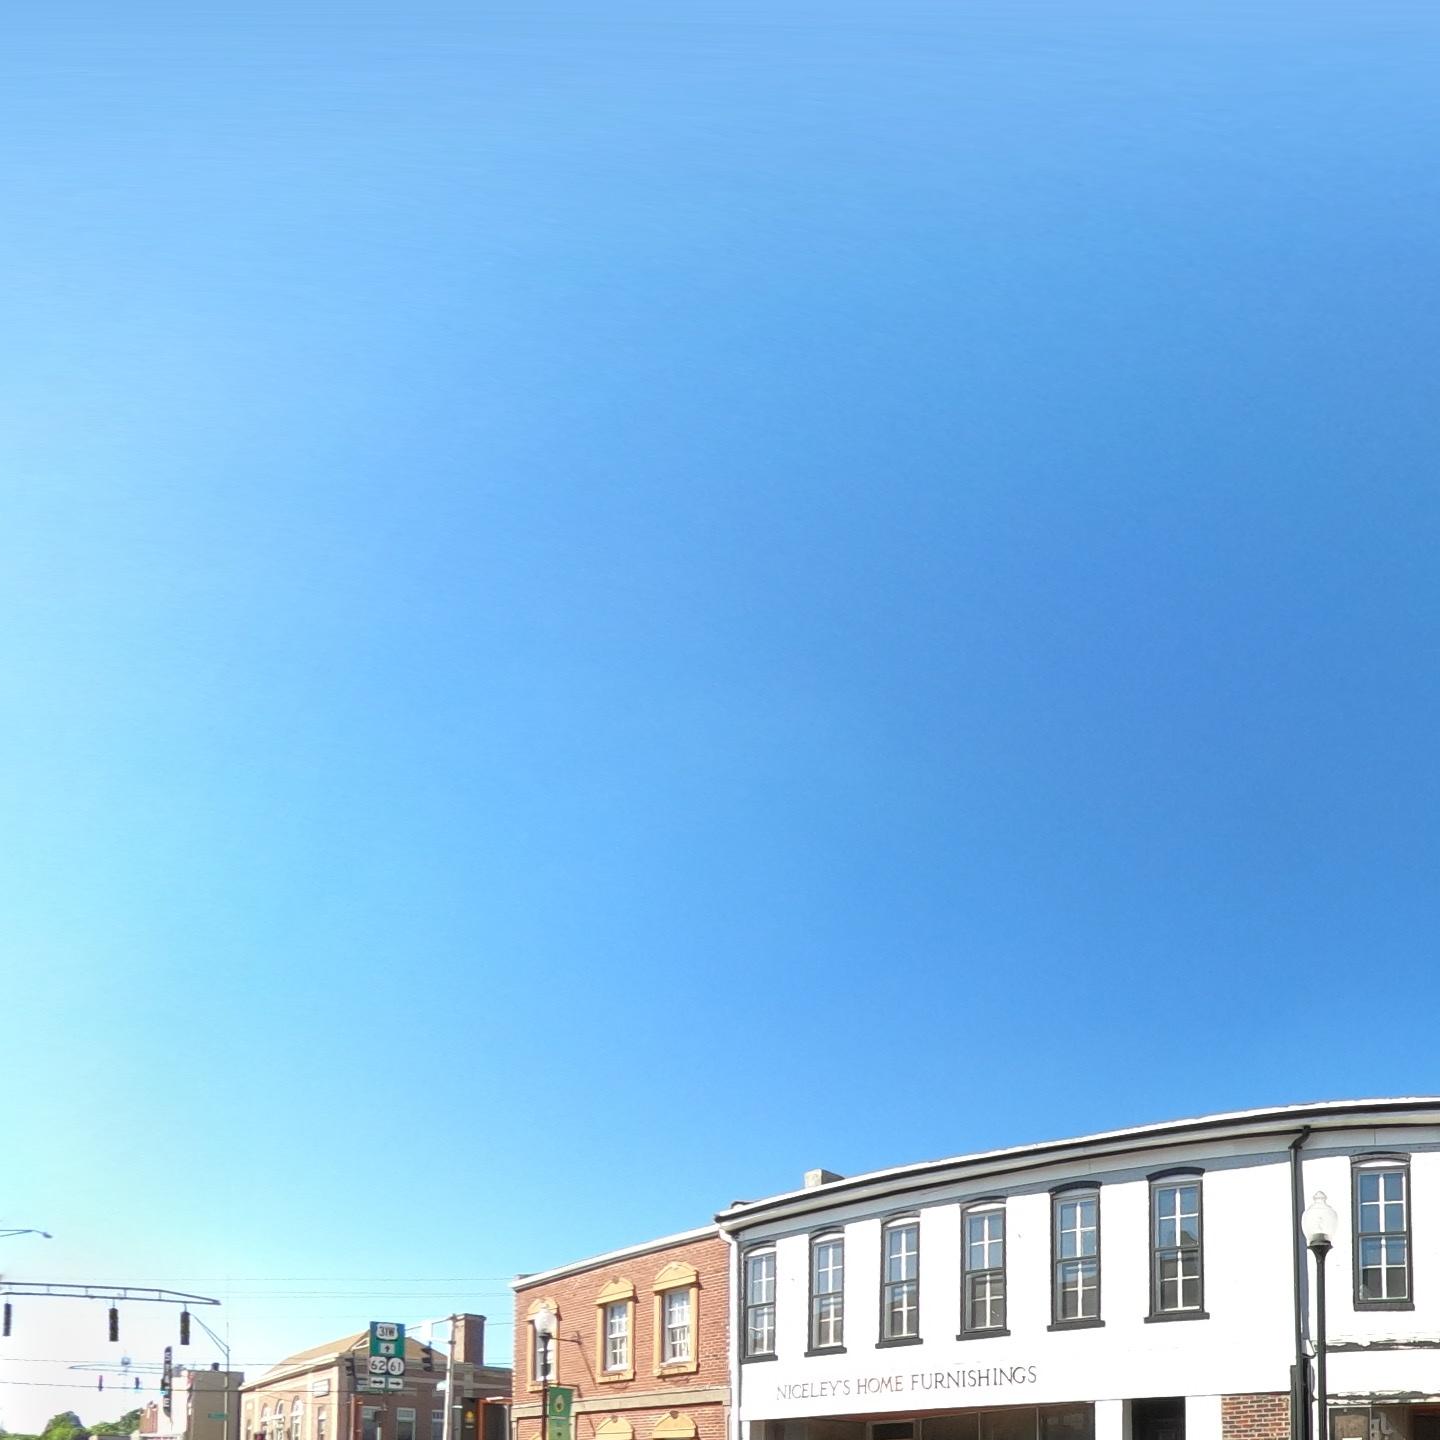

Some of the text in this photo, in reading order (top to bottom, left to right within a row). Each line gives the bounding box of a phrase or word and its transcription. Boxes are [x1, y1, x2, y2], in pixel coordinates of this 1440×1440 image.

[378, 1325, 395, 1337] 31W
[370, 1360, 401, 1372] 62 61
[777, 1365, 1037, 1400] NICELEY'S HOME FURNISHINGS
